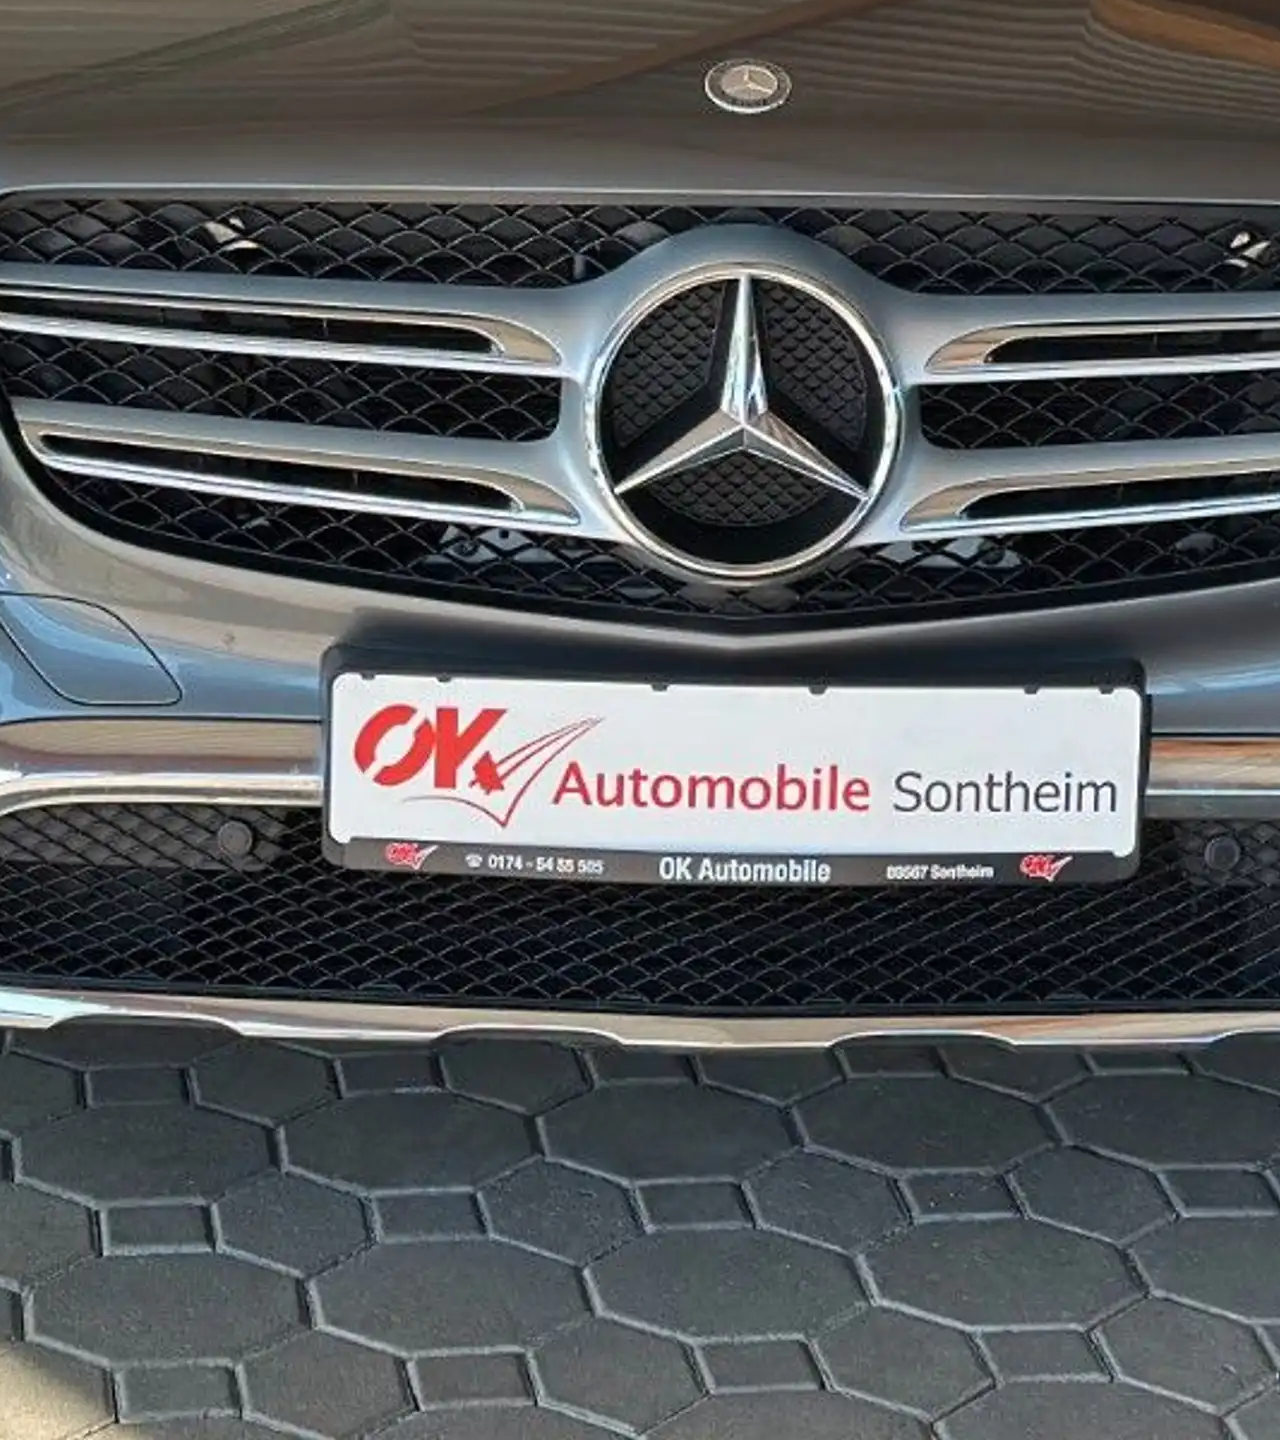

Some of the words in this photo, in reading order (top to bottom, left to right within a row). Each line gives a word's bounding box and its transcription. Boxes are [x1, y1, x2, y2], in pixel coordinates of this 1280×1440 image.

[353, 703, 508, 796] OK
[552, 760, 871, 812] Automobile
[893, 770, 1117, 814] Sontheim
[487, 853, 523, 871] 0174
[658, 856, 691, 881] OK
[697, 857, 831, 883] Automobile
[930, 864, 995, 880] Sontheim
